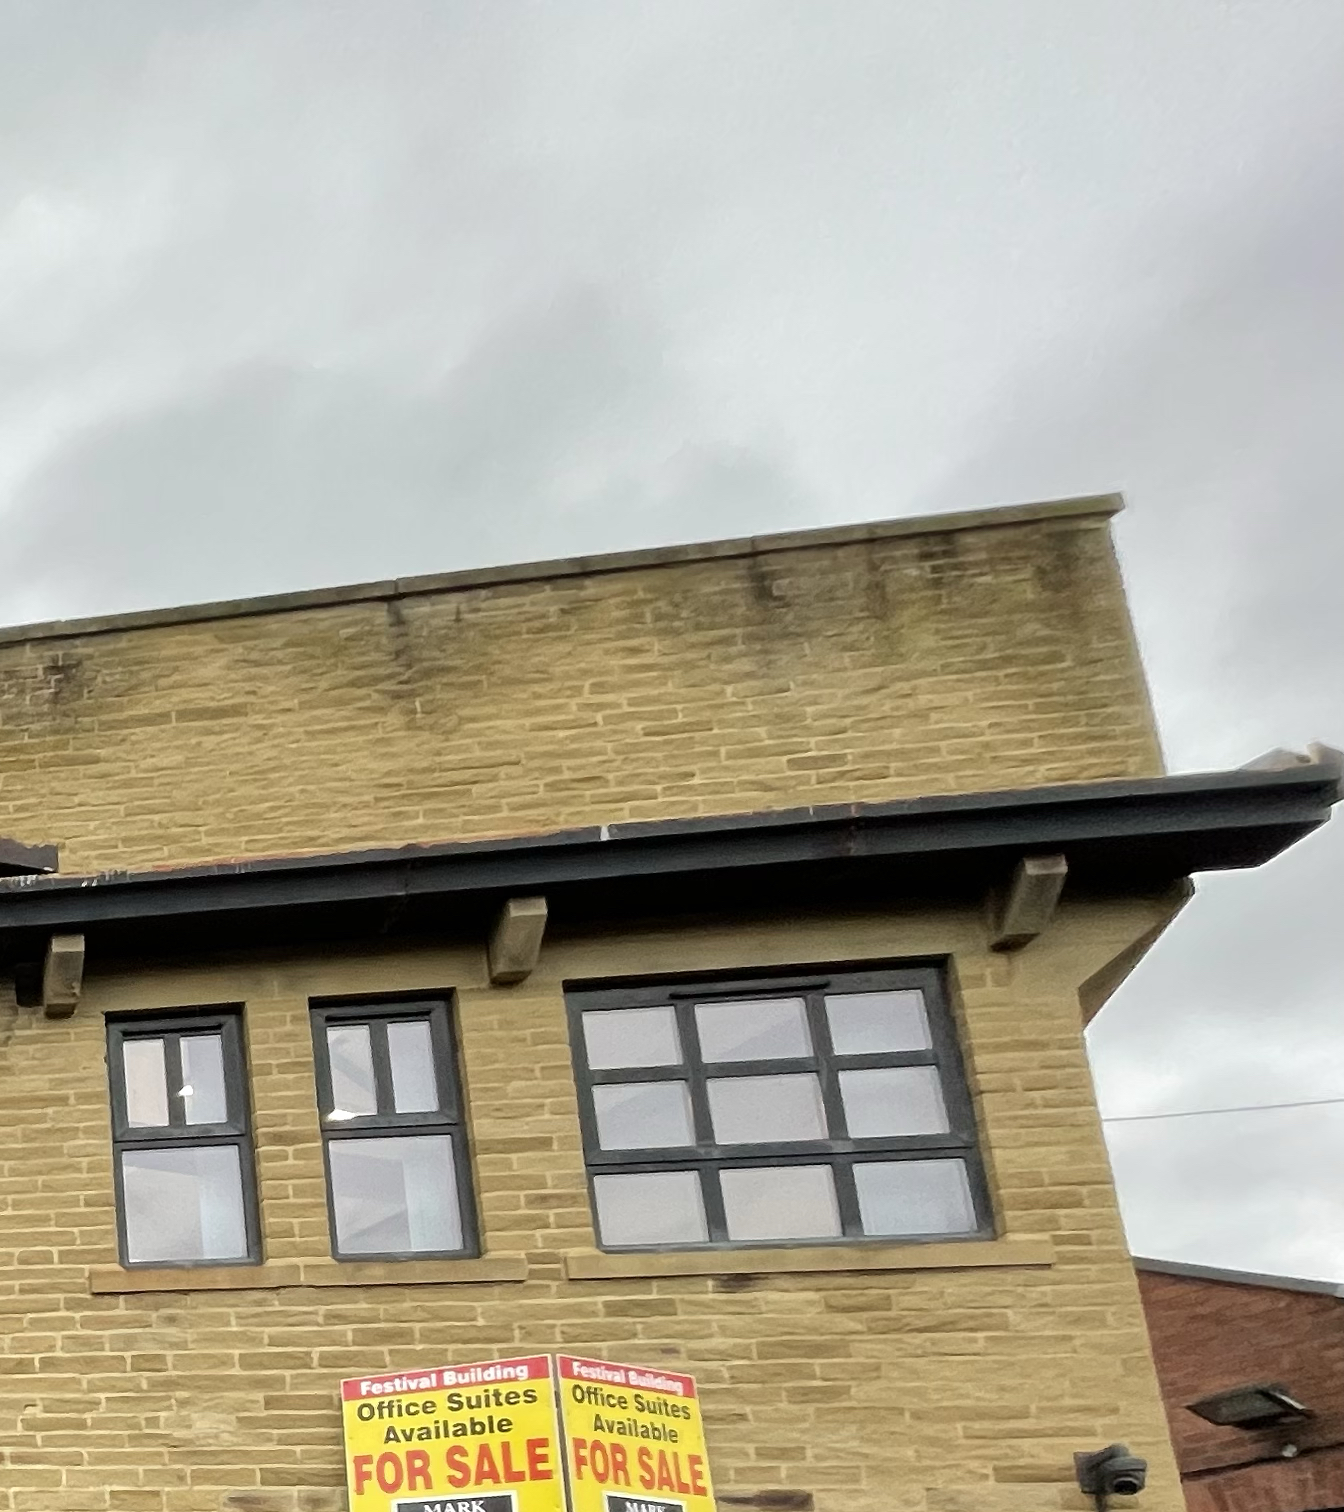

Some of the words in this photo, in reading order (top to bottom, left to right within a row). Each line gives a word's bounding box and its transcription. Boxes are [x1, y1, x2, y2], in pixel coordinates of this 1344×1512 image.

[360, 1373, 437, 1396] Festival
[442, 1364, 529, 1387] Building
[572, 1361, 626, 1384] Festival
[628, 1371, 684, 1396] Building
[357, 1399, 437, 1421] Office
[447, 1388, 538, 1412] Suites
[572, 1384, 628, 1409] Office
[634, 1393, 691, 1420] Suites
[384, 1415, 513, 1444] Available
[594, 1413, 679, 1443] Available
[353, 1449, 433, 1495] FOR
[446, 1438, 553, 1488] SALE
[572, 1437, 631, 1487] FOR
[638, 1446, 708, 1497] SALE
